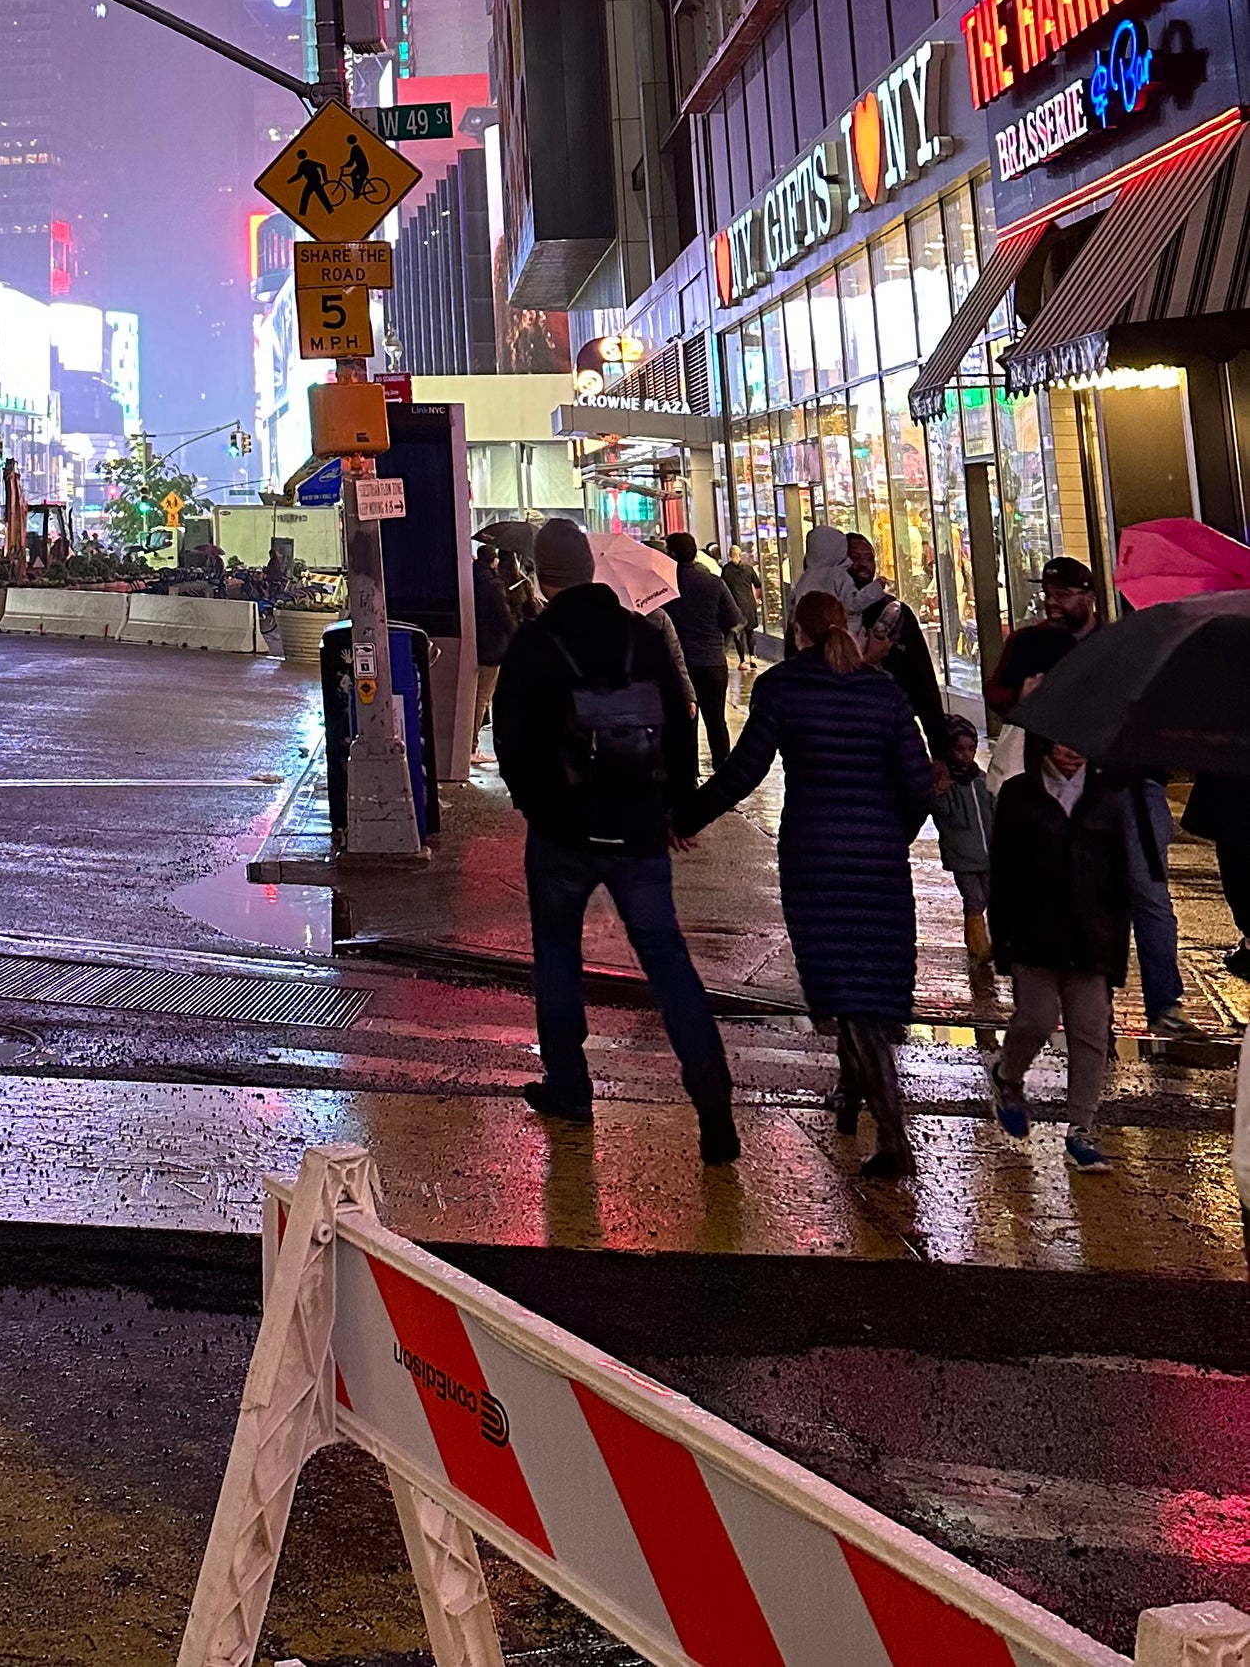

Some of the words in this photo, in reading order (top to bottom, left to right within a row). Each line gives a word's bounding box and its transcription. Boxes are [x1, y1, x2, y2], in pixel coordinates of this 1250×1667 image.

[995, 79, 1089, 183] BRASSERIE
[1109, 18, 1153, 114] Bar
[381, 111, 399, 137] W
[406, 109, 429, 135] 49
[436, 108, 449, 124] St
[764, 142, 832, 273] GIFTS
[877, 40, 940, 190] NY.
[300, 249, 351, 263] SHARE
[358, 249, 387, 263] THE
[321, 268, 365, 281] ROAD
[321, 295, 348, 329] 5
[411, 406, 446, 415] LinkNYC
[578, 392, 640, 411] CROWNE
[645, 398, 692, 416] PLAZA
[393, 1342, 477, 1414] conEdison
